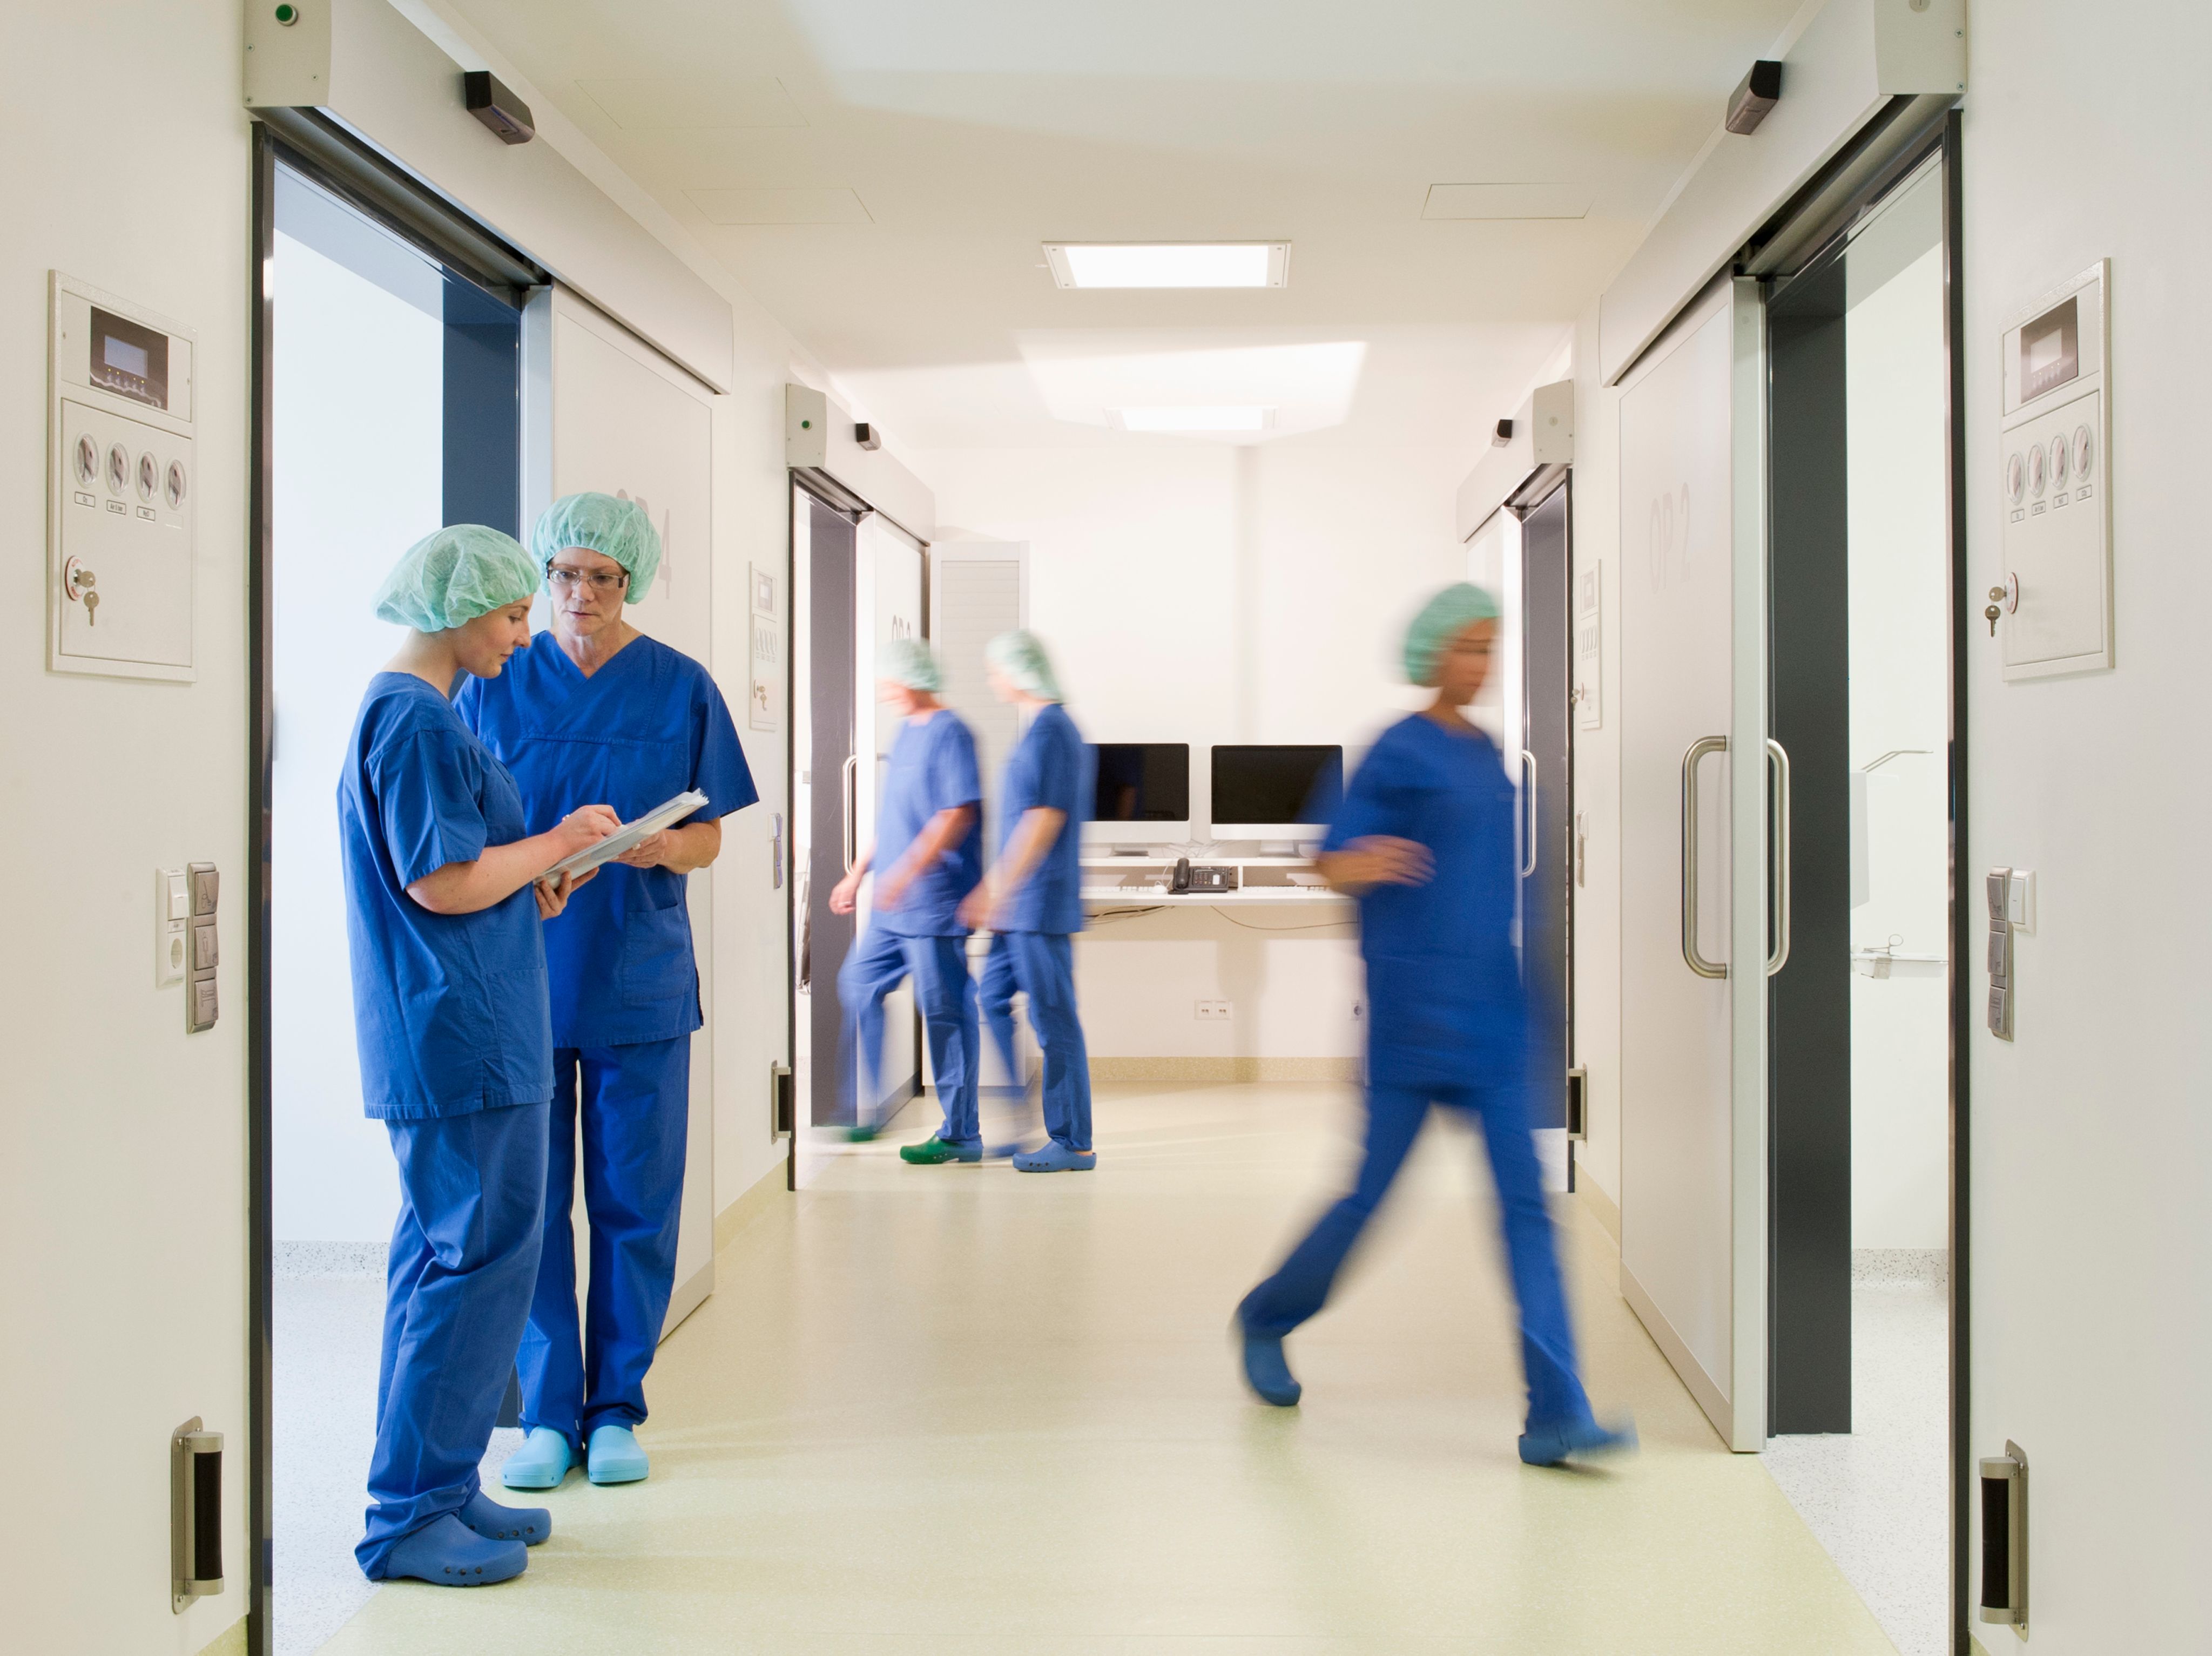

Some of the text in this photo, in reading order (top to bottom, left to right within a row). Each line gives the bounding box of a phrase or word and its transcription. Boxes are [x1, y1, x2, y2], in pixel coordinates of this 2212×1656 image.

[659, 509, 672, 599] 4
[1650, 482, 1690, 593] OP 2
